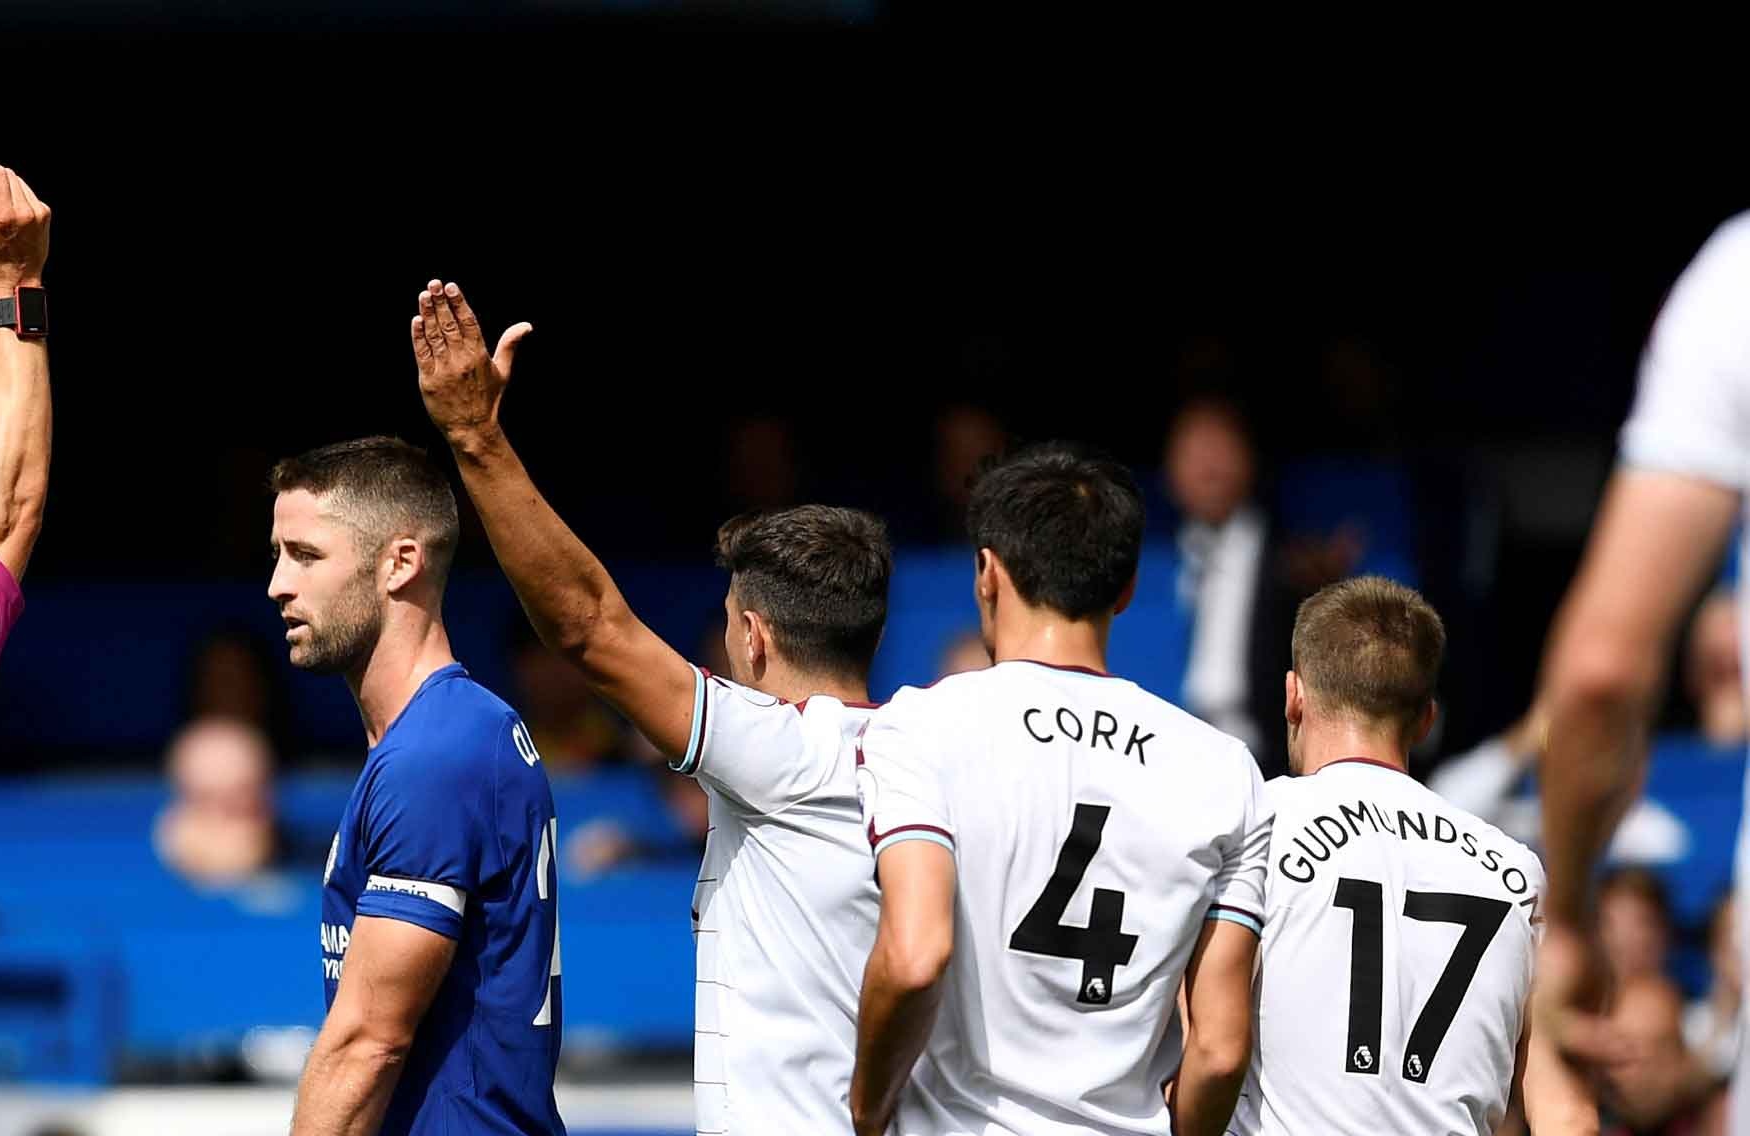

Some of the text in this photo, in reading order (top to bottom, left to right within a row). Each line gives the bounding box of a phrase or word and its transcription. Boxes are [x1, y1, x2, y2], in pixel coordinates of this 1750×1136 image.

[1022, 706, 1156, 766] CORK
[1009, 803, 1139, 1006] 4
[1332, 877, 1513, 1085] 17
